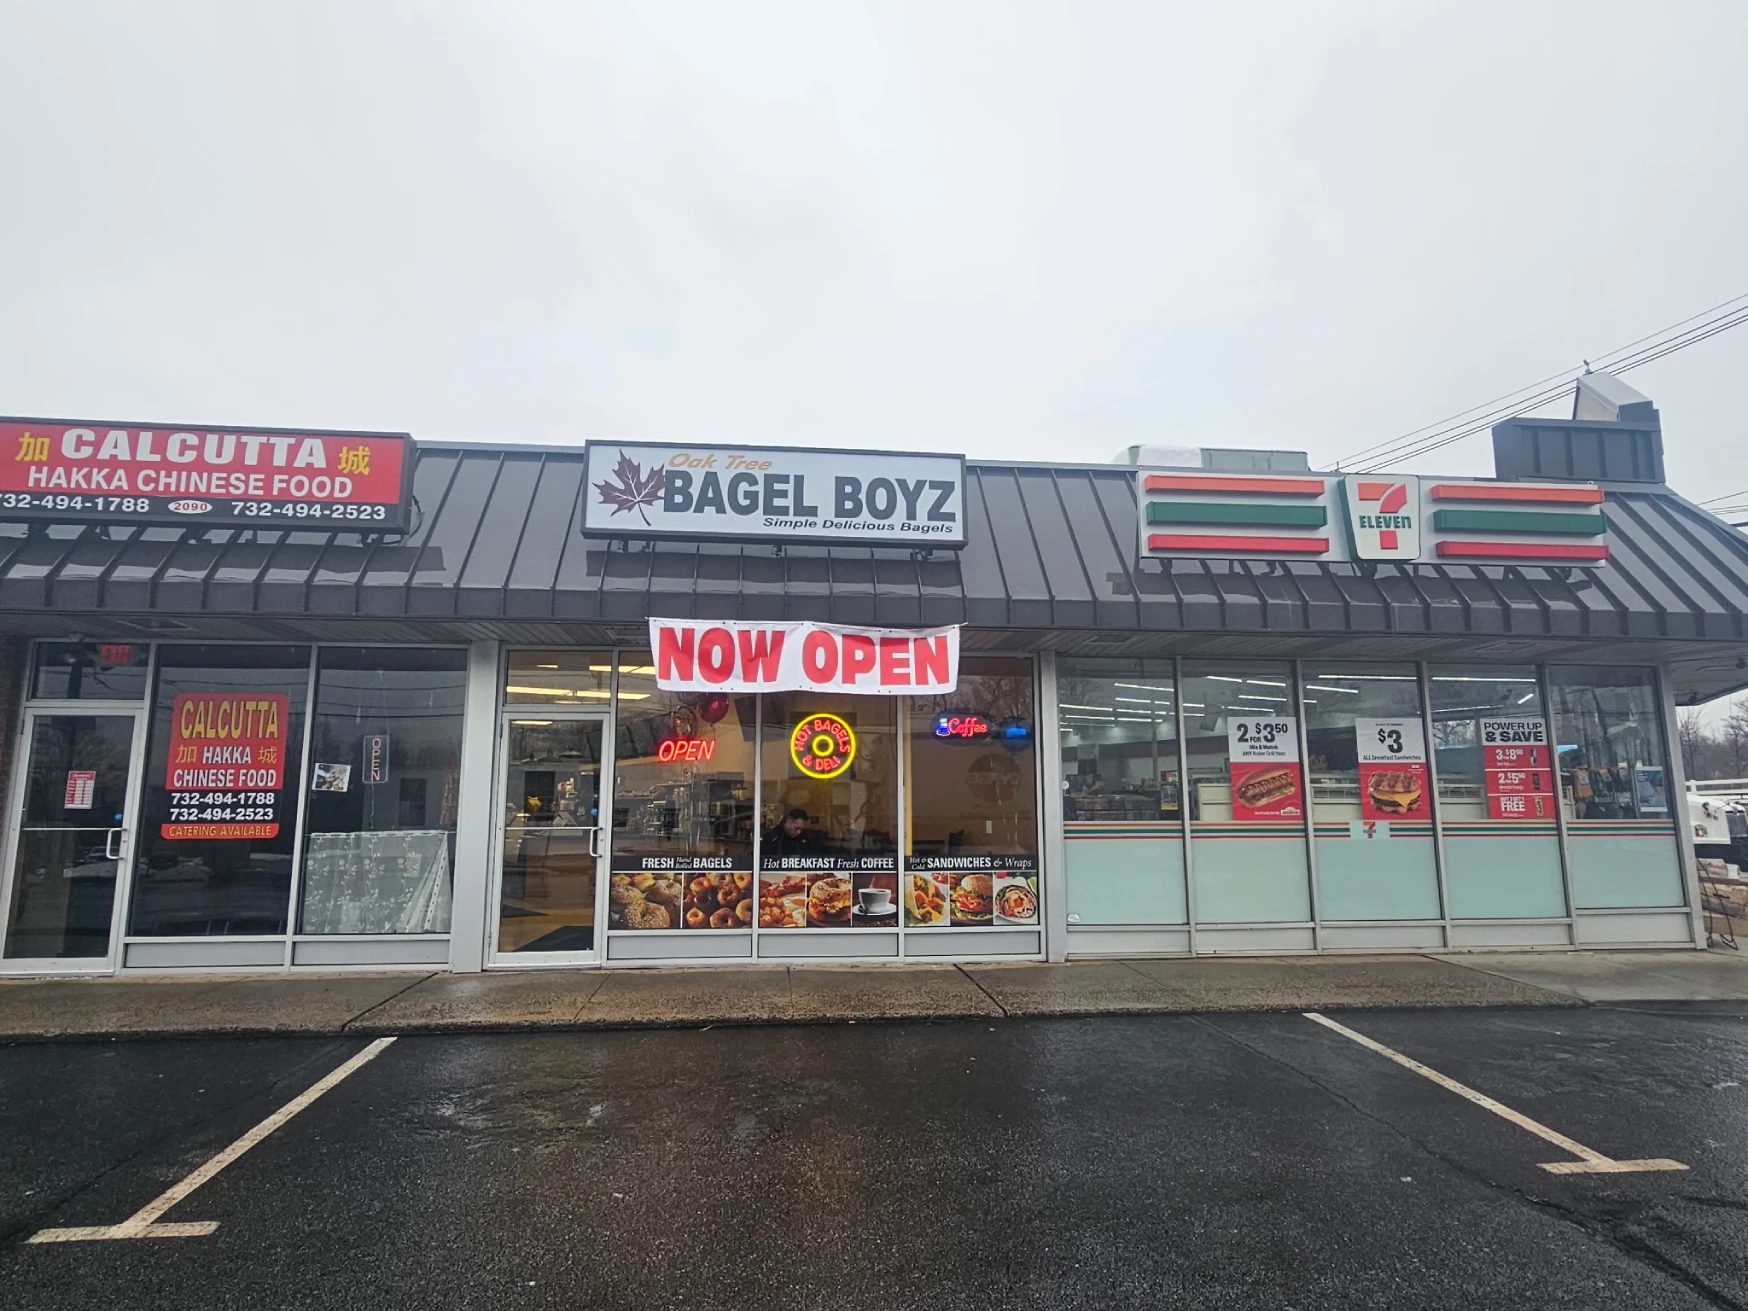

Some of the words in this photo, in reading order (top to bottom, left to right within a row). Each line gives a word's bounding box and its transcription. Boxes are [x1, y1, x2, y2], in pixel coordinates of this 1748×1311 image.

[15, 432, 50, 461] 加
[61, 428, 327, 468] CALCUTTA
[338, 445, 371, 475] 城
[668, 453, 718, 468] Oak
[725, 454, 773, 471] Tree
[28, 466, 129, 490] HAKKA
[137, 469, 265, 495] CHINESE
[272, 474, 353, 498] FOOD
[0, 493, 149, 512] 32-494-1788
[663, 469, 818, 517] BAGEL
[834, 476, 956, 522] BOYZ
[173, 502, 208, 512] 2090
[231, 501, 386, 520] 732-494-2523
[1357, 482, 1408, 549] 7
[763, 517, 818, 530] Simple
[822, 519, 895, 531] Delicious
[900, 522, 953, 534] Bagels
[658, 627, 785, 684] NOW
[802, 630, 949, 686] OPEN
[181, 700, 278, 739] CALCUTTA
[948, 717, 988, 737] Coffee
[1484, 722, 1525, 731] POWER
[1527, 722, 1542, 731] UP
[794, 724, 812, 751] HOT
[814, 719, 851, 752] BAGELS
[1237, 723, 1249, 743] 2
[1378, 728, 1403, 753] $3
[1485, 731, 1497, 742] &
[1500, 731, 1544, 742] SAVE
[175, 744, 197, 763] 加
[202, 746, 251, 764] HAKKA
[258, 746, 278, 763] 城
[371, 738, 381, 781] OPEN
[659, 740, 715, 761] OPEN
[815, 756, 841, 770] DELI
[173, 769, 234, 787] CHINESE
[239, 769, 277, 787] FOOD
[171, 792, 275, 805] 732-494-1788
[1501, 801, 1526, 811] FREE
[170, 808, 274, 820] 732-494-2523
[169, 826, 216, 837] CATERING
[220, 826, 272, 836] AVAILABLE
[642, 858, 674, 868] FRESH
[693, 858, 732, 868] BAGELS
[764, 859, 780, 868] Hot
[781, 858, 835, 868] BREAKFAST
[837, 858, 859, 868] Fresh
[861, 858, 894, 868] COFFEE
[927, 857, 991, 868] SANDWICHES
[1005, 858, 1031, 870] Wraps
